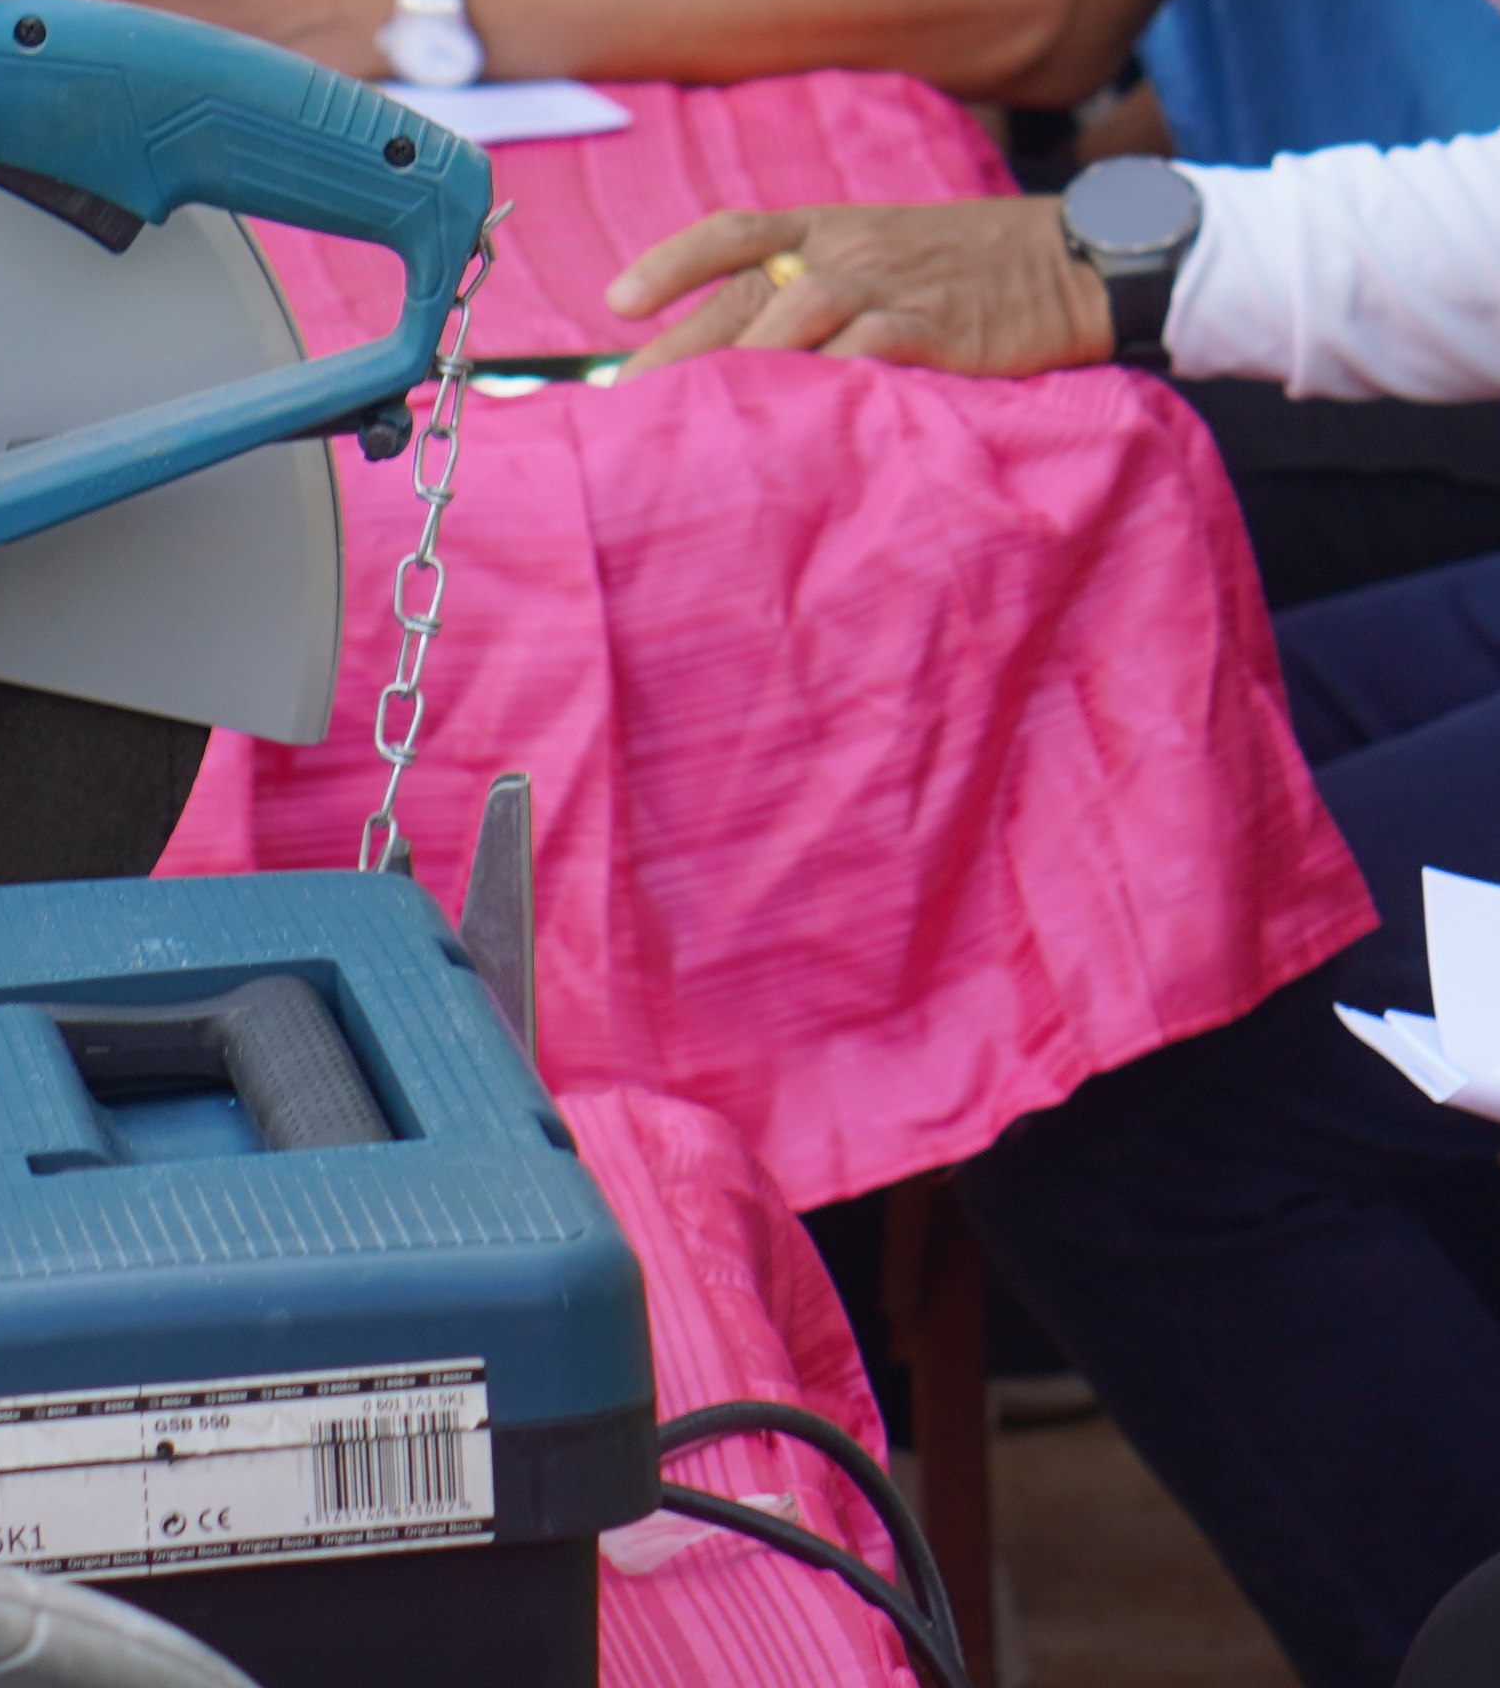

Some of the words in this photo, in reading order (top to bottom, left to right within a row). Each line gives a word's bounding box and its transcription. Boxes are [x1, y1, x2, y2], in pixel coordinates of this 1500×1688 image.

[155, 1415, 193, 1433] GSB
[199, 1413, 231, 1430] 550
[153, 1547, 195, 1562] Original
[237, 1539, 280, 1554] Original
[321, 1530, 364, 1546] Original
[404, 1522, 447, 1538] Original
